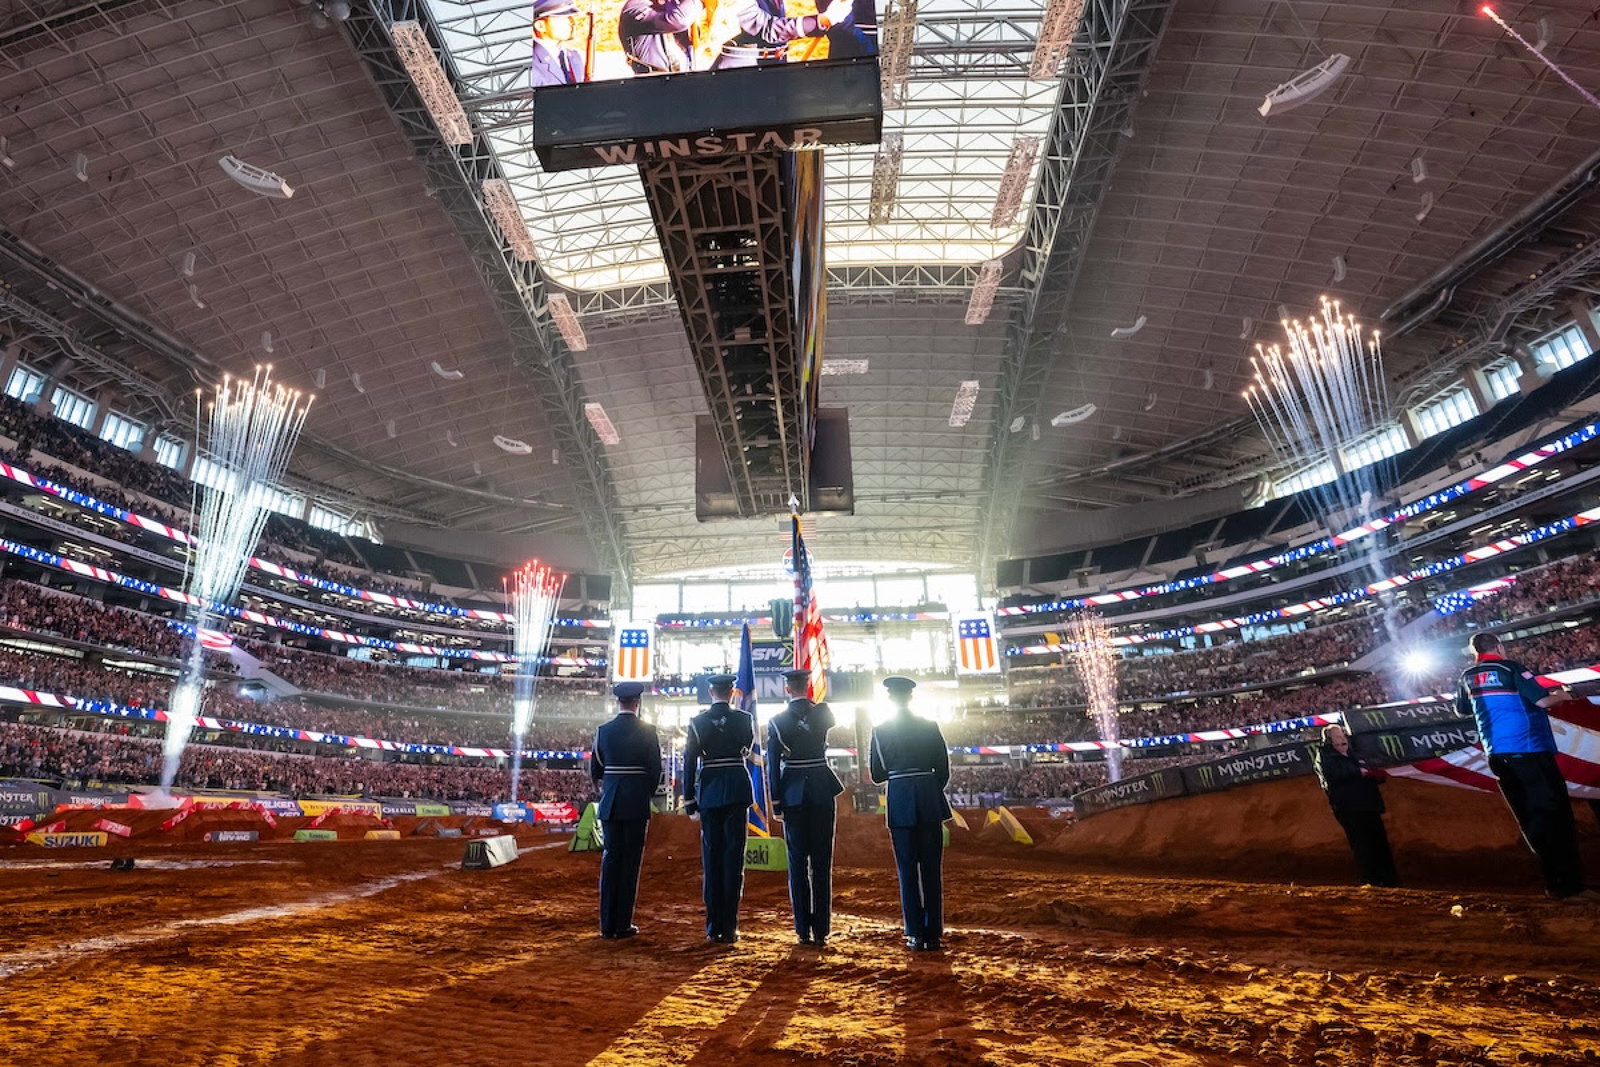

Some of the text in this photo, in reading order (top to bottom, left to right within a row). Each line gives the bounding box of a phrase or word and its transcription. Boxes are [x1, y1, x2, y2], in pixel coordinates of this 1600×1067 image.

[594, 128, 823, 164] WINSTAR
[1218, 749, 1301, 777] MONSTER
[1233, 767, 1291, 783] ENERGY
[1095, 780, 1148, 803] MONSTER
[44, 835, 99, 847] SUZUKI
[746, 844, 769, 864] saki
